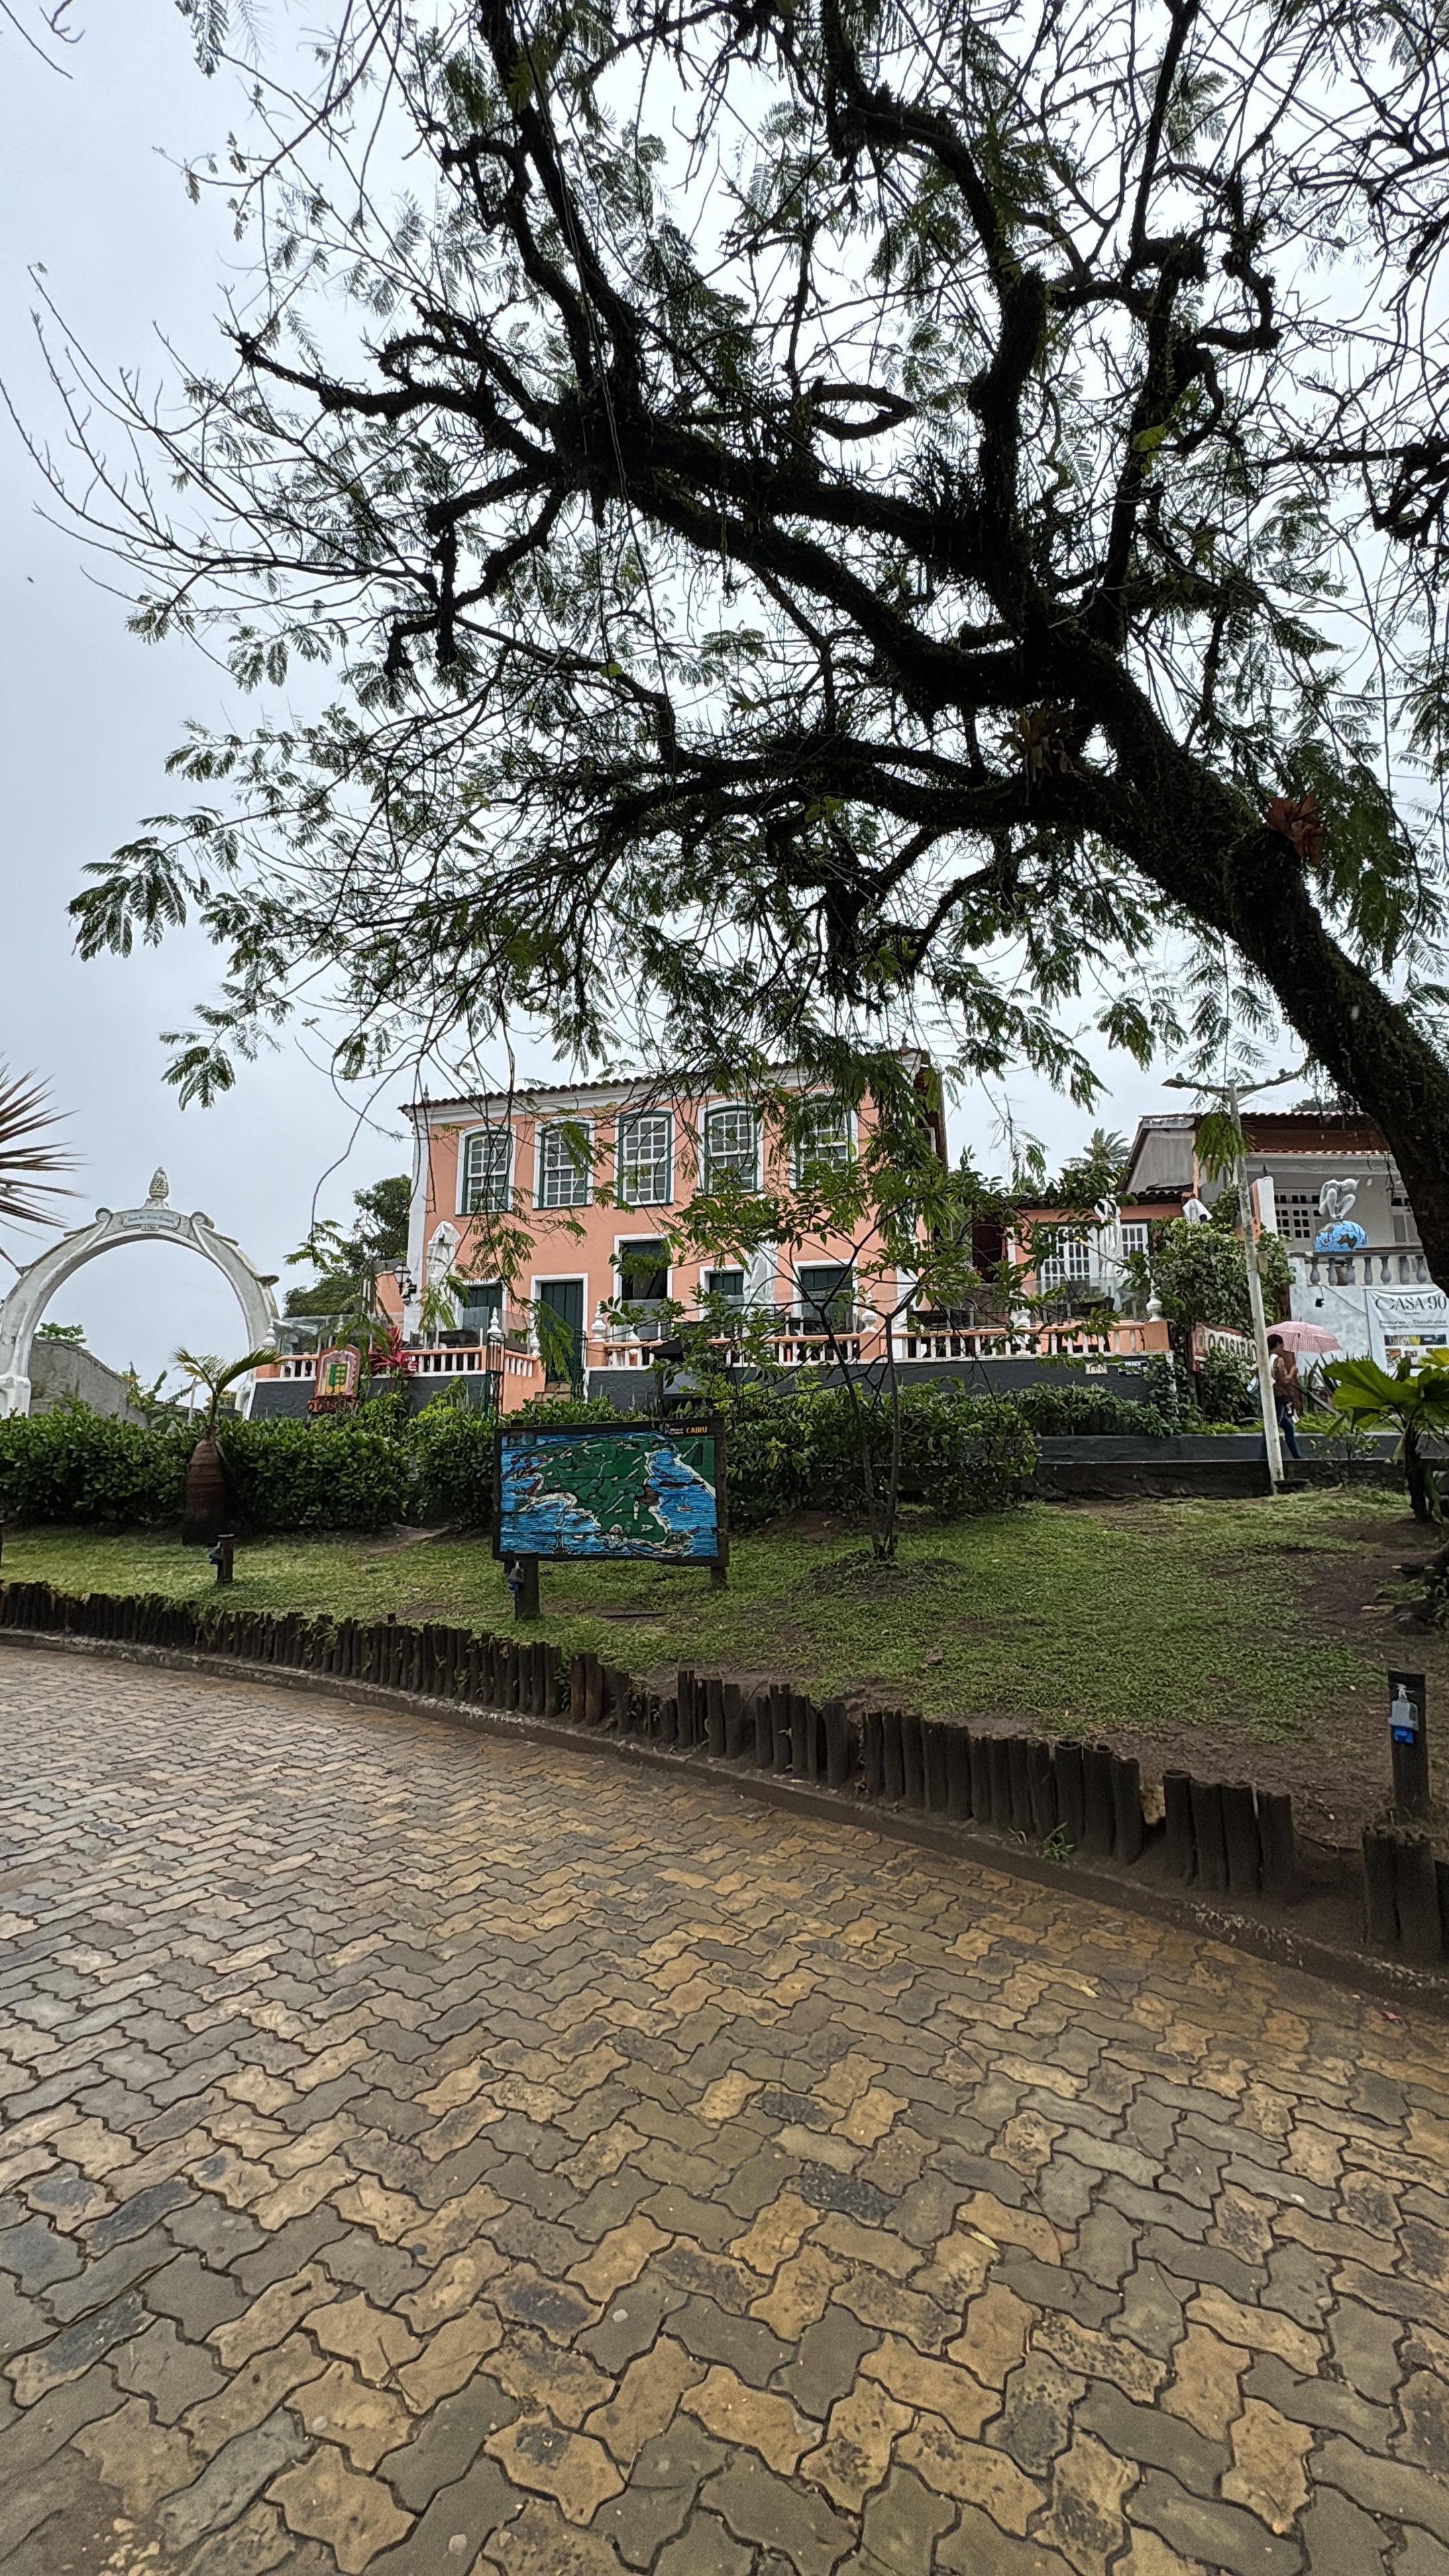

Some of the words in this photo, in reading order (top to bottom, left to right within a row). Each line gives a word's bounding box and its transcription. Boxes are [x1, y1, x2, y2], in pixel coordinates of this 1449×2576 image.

[1375, 1295, 1425, 1311] CASA
[1427, 1295, 1447, 1310] 90
[686, 1426, 708, 1434] CAIRU
